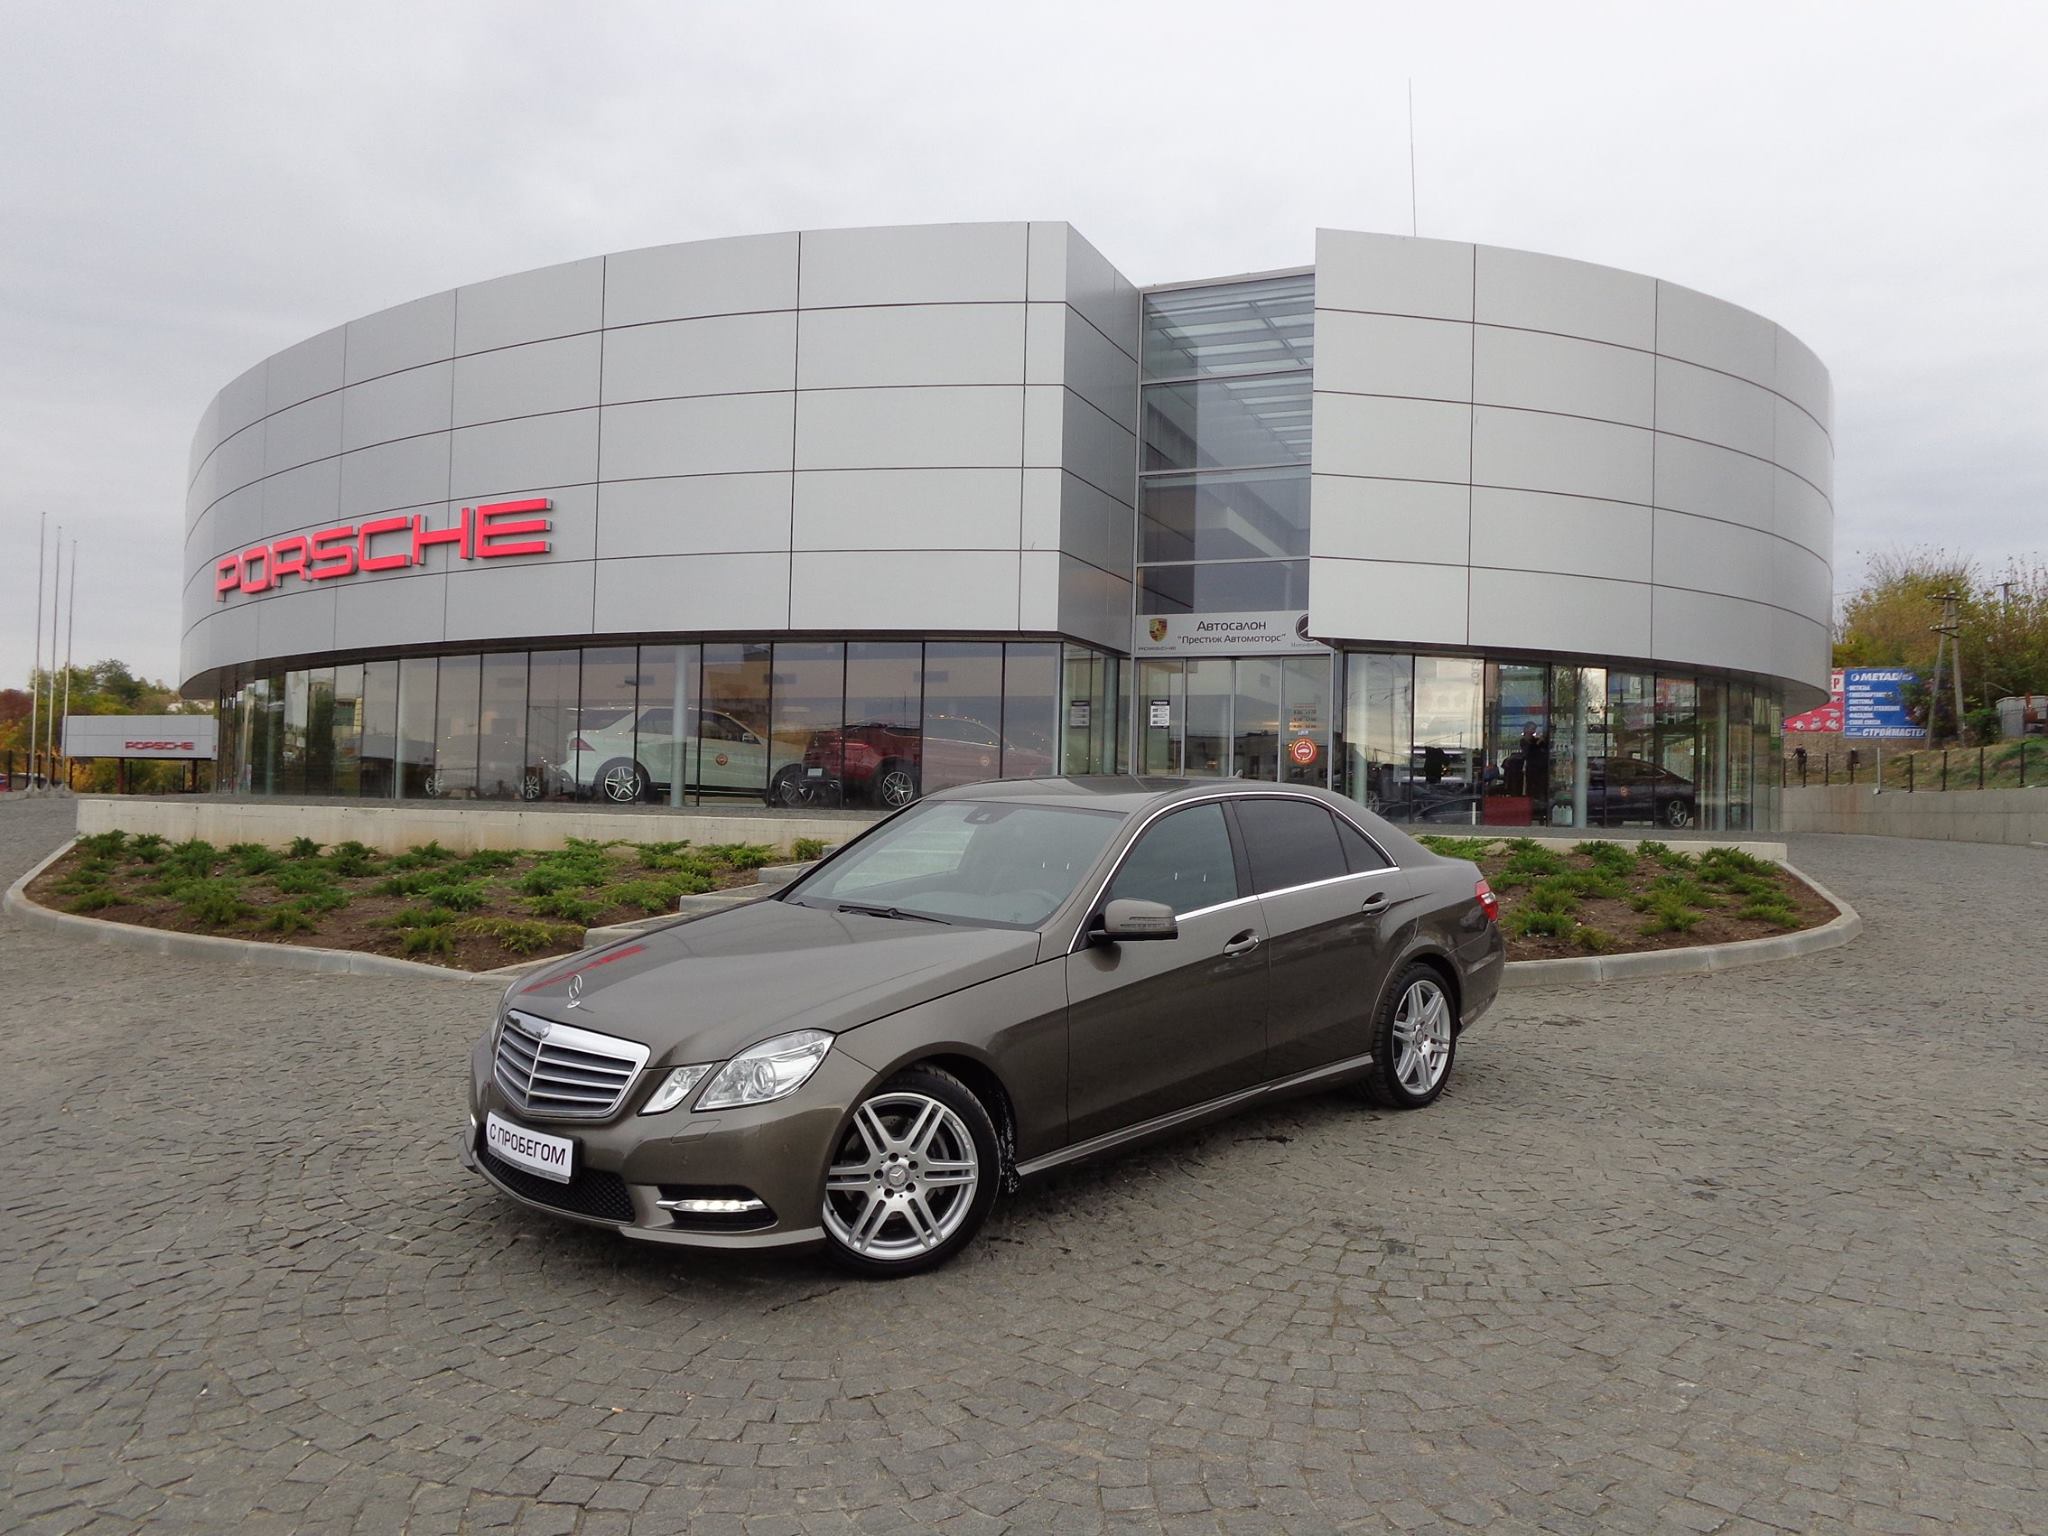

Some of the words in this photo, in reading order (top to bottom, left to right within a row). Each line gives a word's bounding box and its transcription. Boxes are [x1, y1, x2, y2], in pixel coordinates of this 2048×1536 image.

[216, 498, 553, 602] PORSCHE
[1177, 634, 1222, 646] "Престиж
[1224, 633, 1287, 644] Автомоторс"
[1196, 620, 1267, 632] Автосалон
[489, 1123, 497, 1140] С
[498, 1127, 567, 1166] ПРОБЕГОМ
